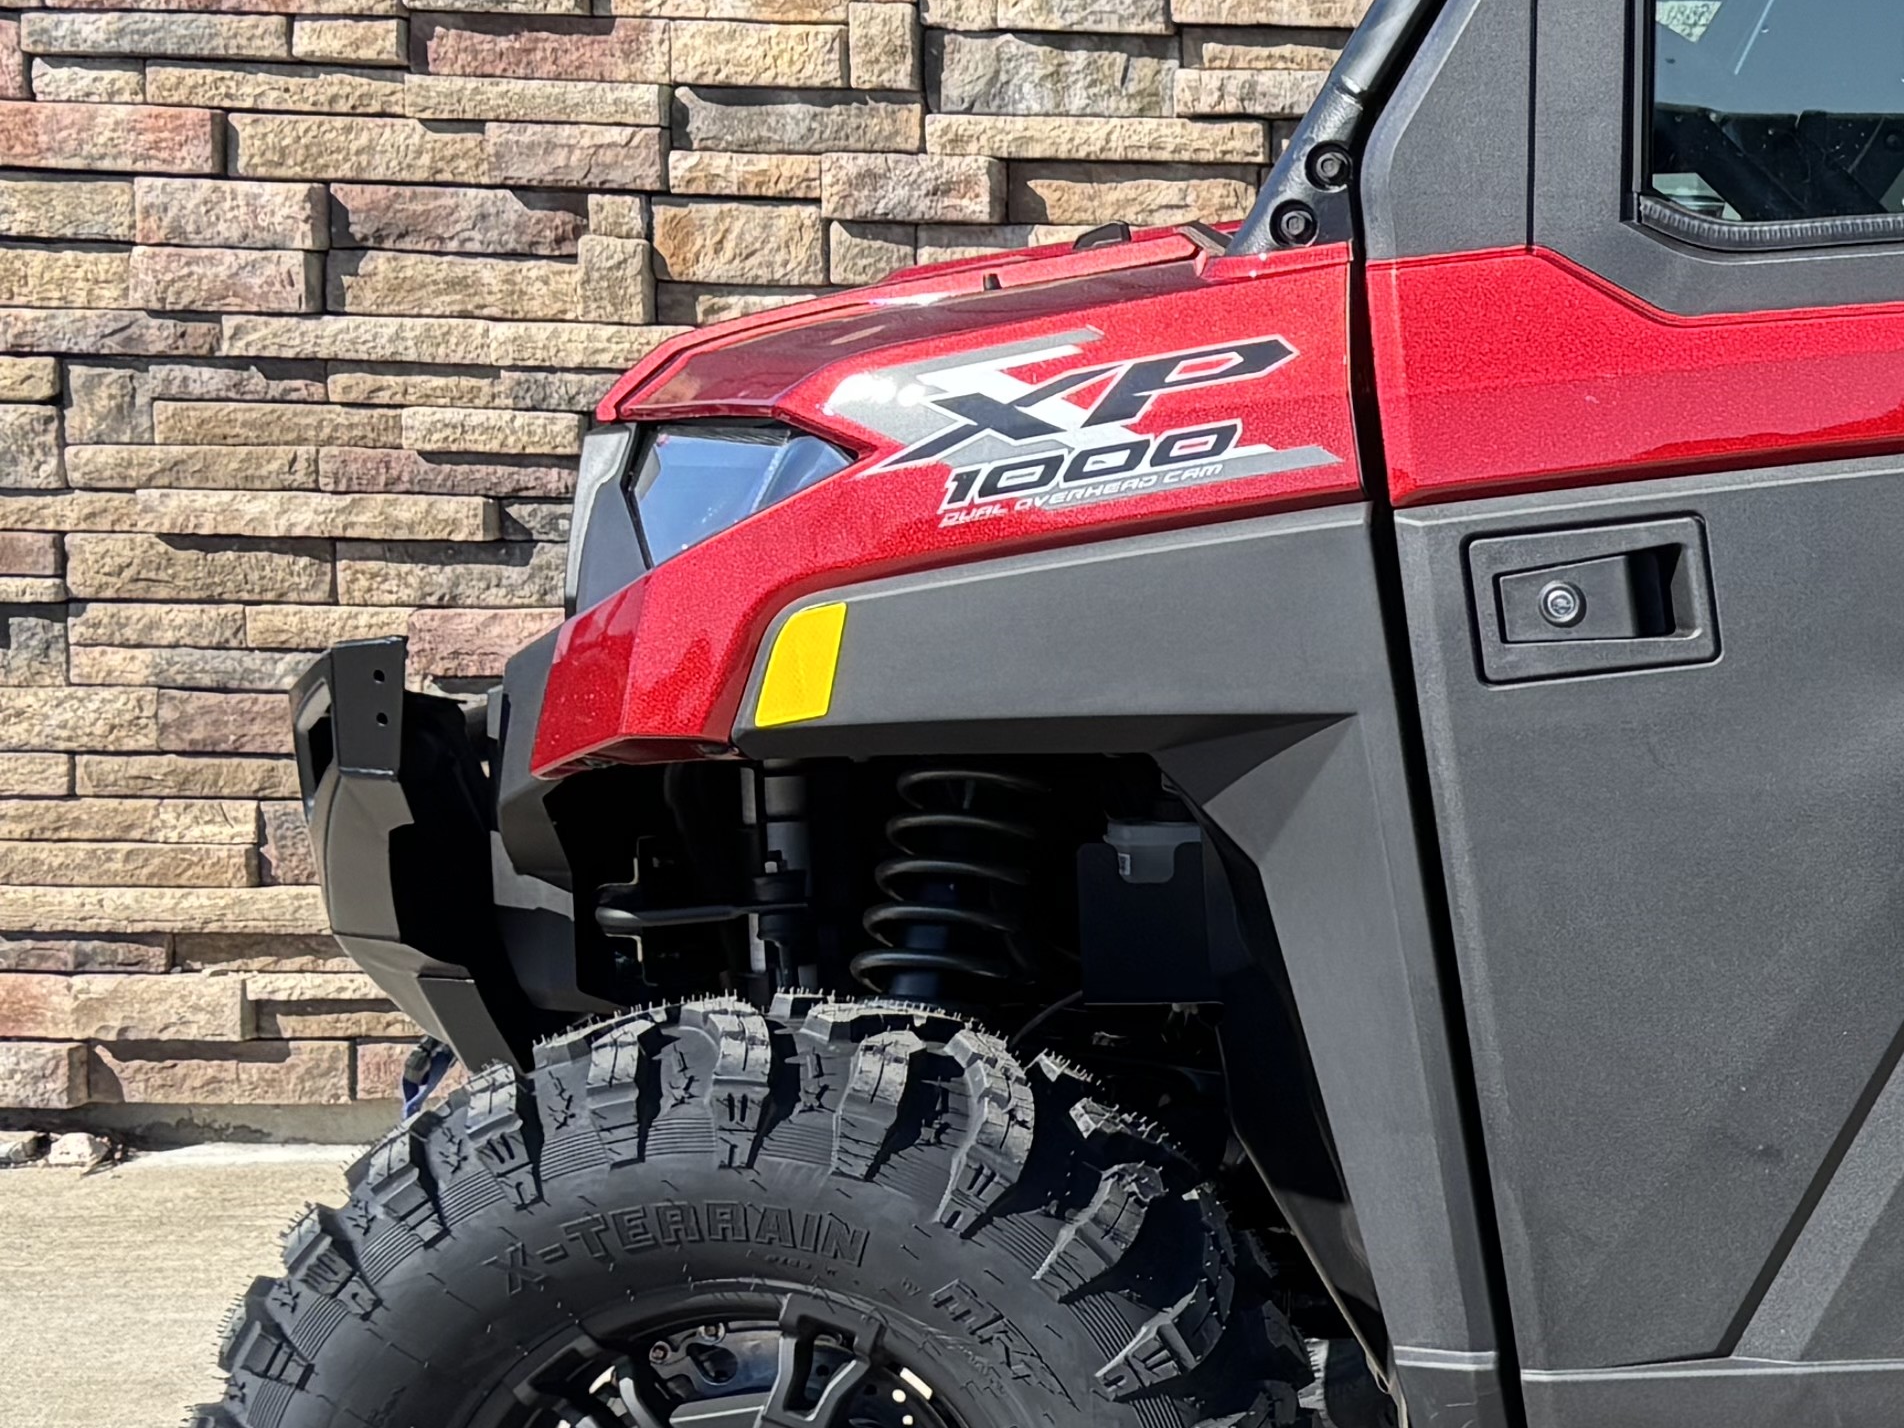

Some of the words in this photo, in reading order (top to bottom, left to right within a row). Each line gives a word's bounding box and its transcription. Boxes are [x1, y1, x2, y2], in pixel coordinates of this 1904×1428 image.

[868, 336, 1298, 471] XP
[939, 502, 1008, 528] DUAL
[1014, 475, 1162, 512] OVERHEAD
[1163, 462, 1224, 484] CAM
[940, 420, 1241, 509] 1000
[481, 1199, 871, 1296] X-TERRAIN
